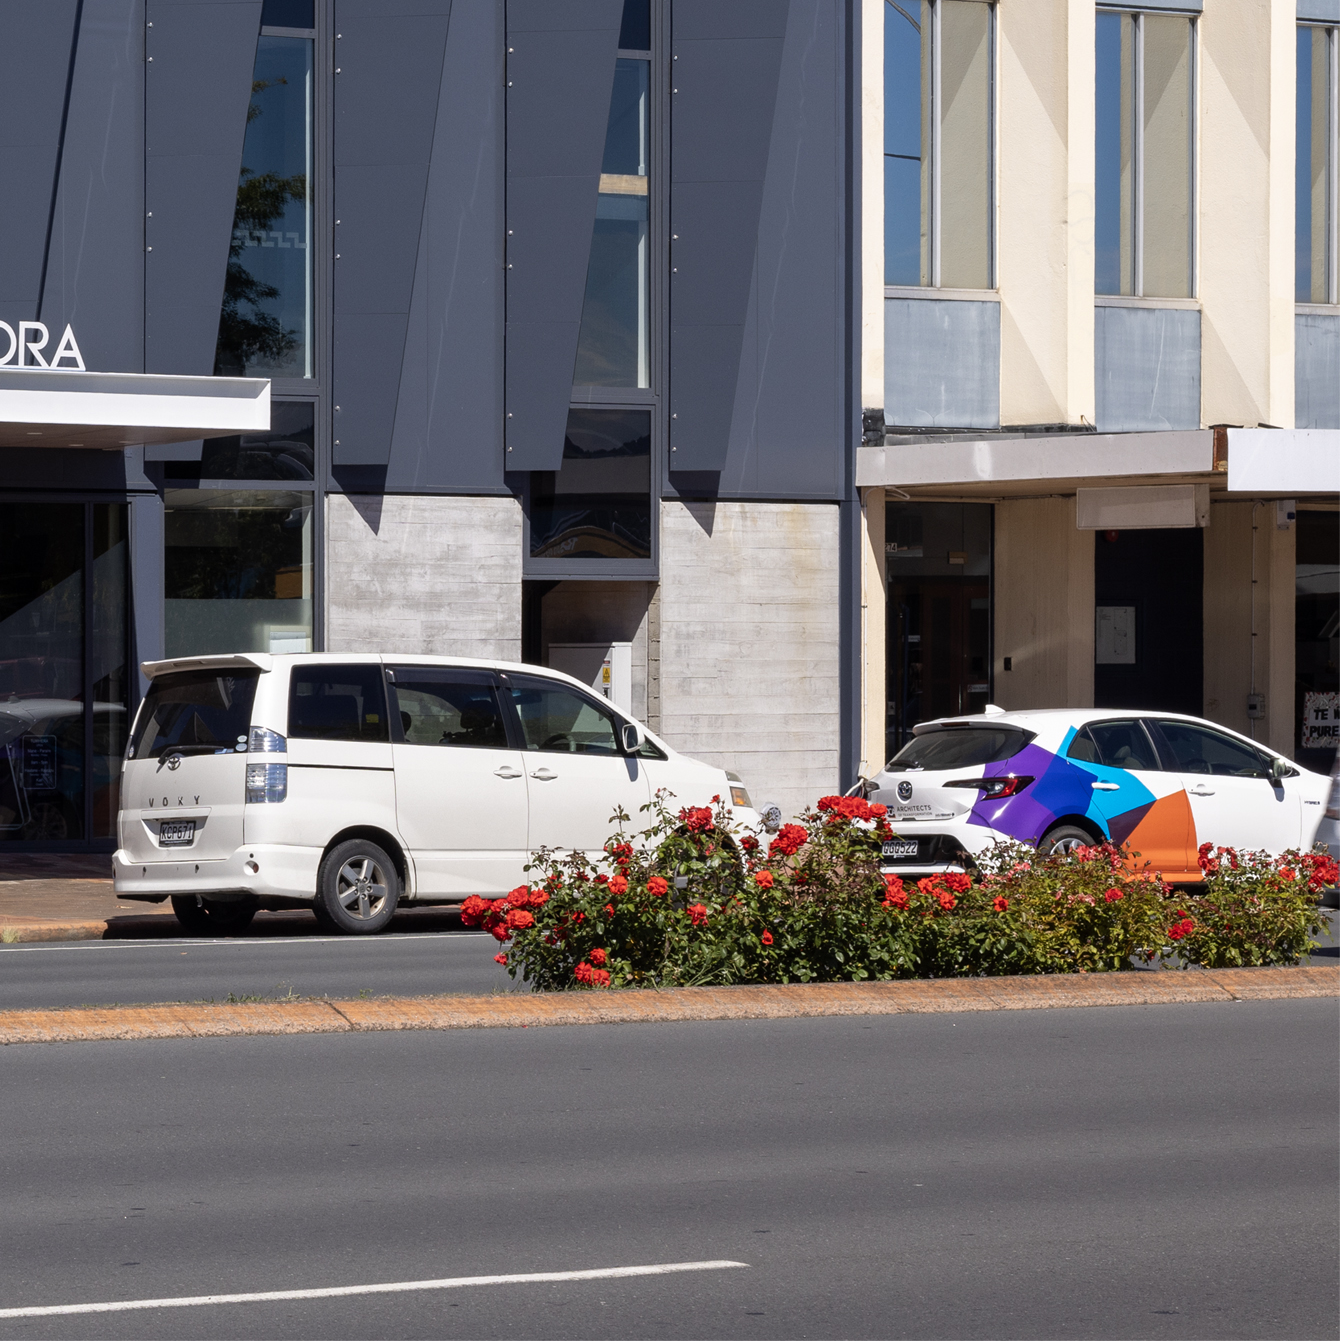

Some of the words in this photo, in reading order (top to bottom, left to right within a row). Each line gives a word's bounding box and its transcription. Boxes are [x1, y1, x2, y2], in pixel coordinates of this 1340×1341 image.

[1314, 709, 1329, 720] TE
[148, 795, 200, 807] VOXY
[897, 804, 932, 812] ARCHITECTS
[161, 825, 194, 840] KCP671
